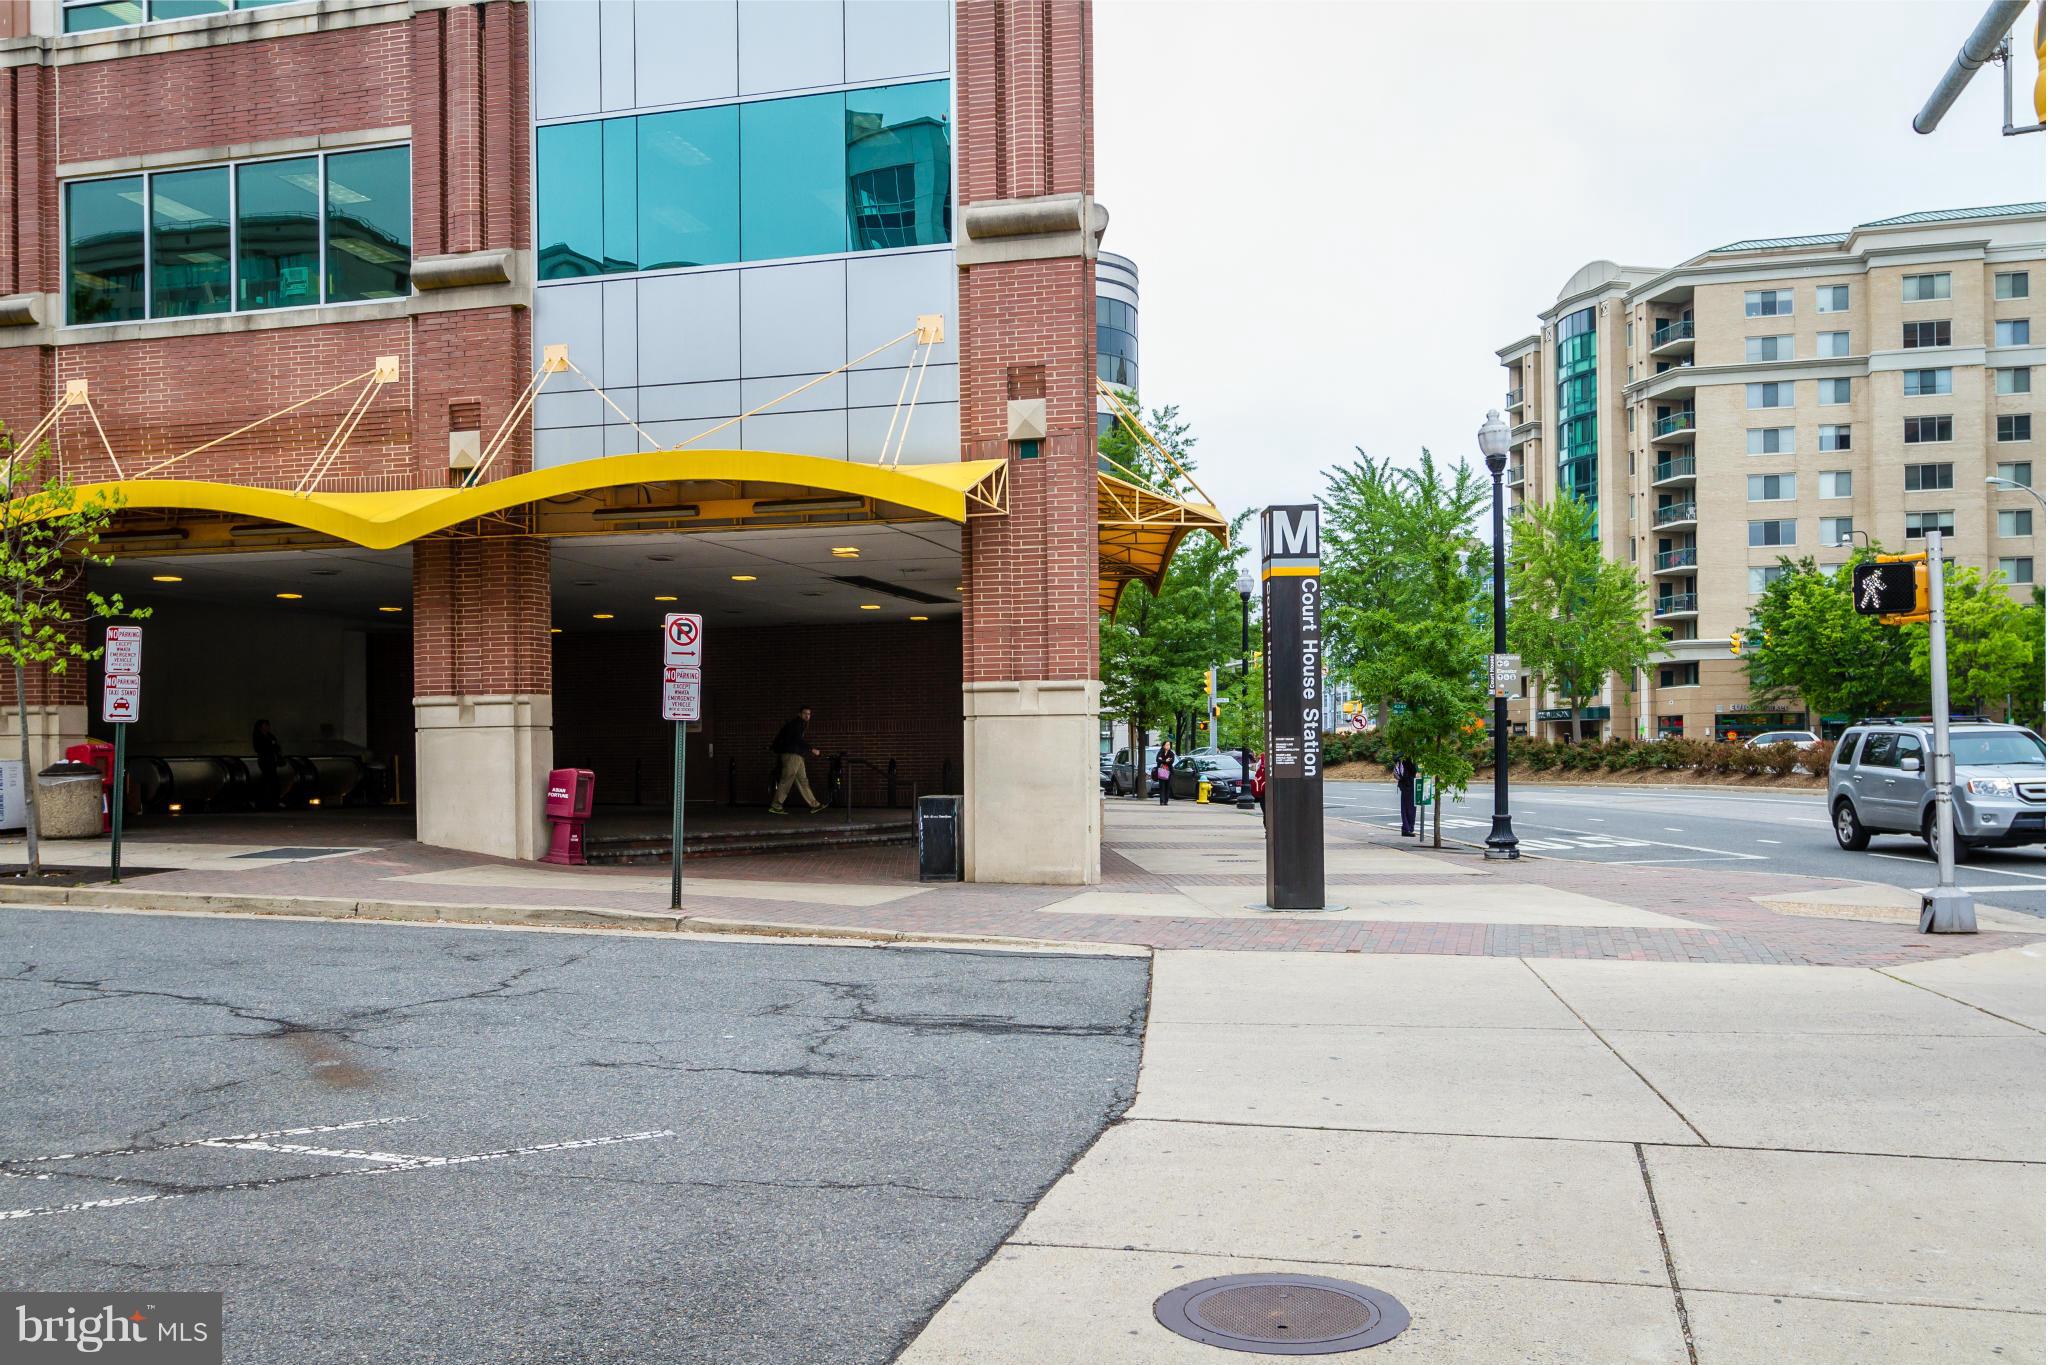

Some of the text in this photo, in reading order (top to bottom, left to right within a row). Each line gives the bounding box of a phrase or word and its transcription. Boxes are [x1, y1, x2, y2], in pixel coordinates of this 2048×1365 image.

[1273, 511, 1316, 554] M
[109, 629, 118, 639] NO
[665, 670, 676, 680] NO
[1302, 578, 1320, 776] Court House Station
[107, 677, 116, 687] NO
